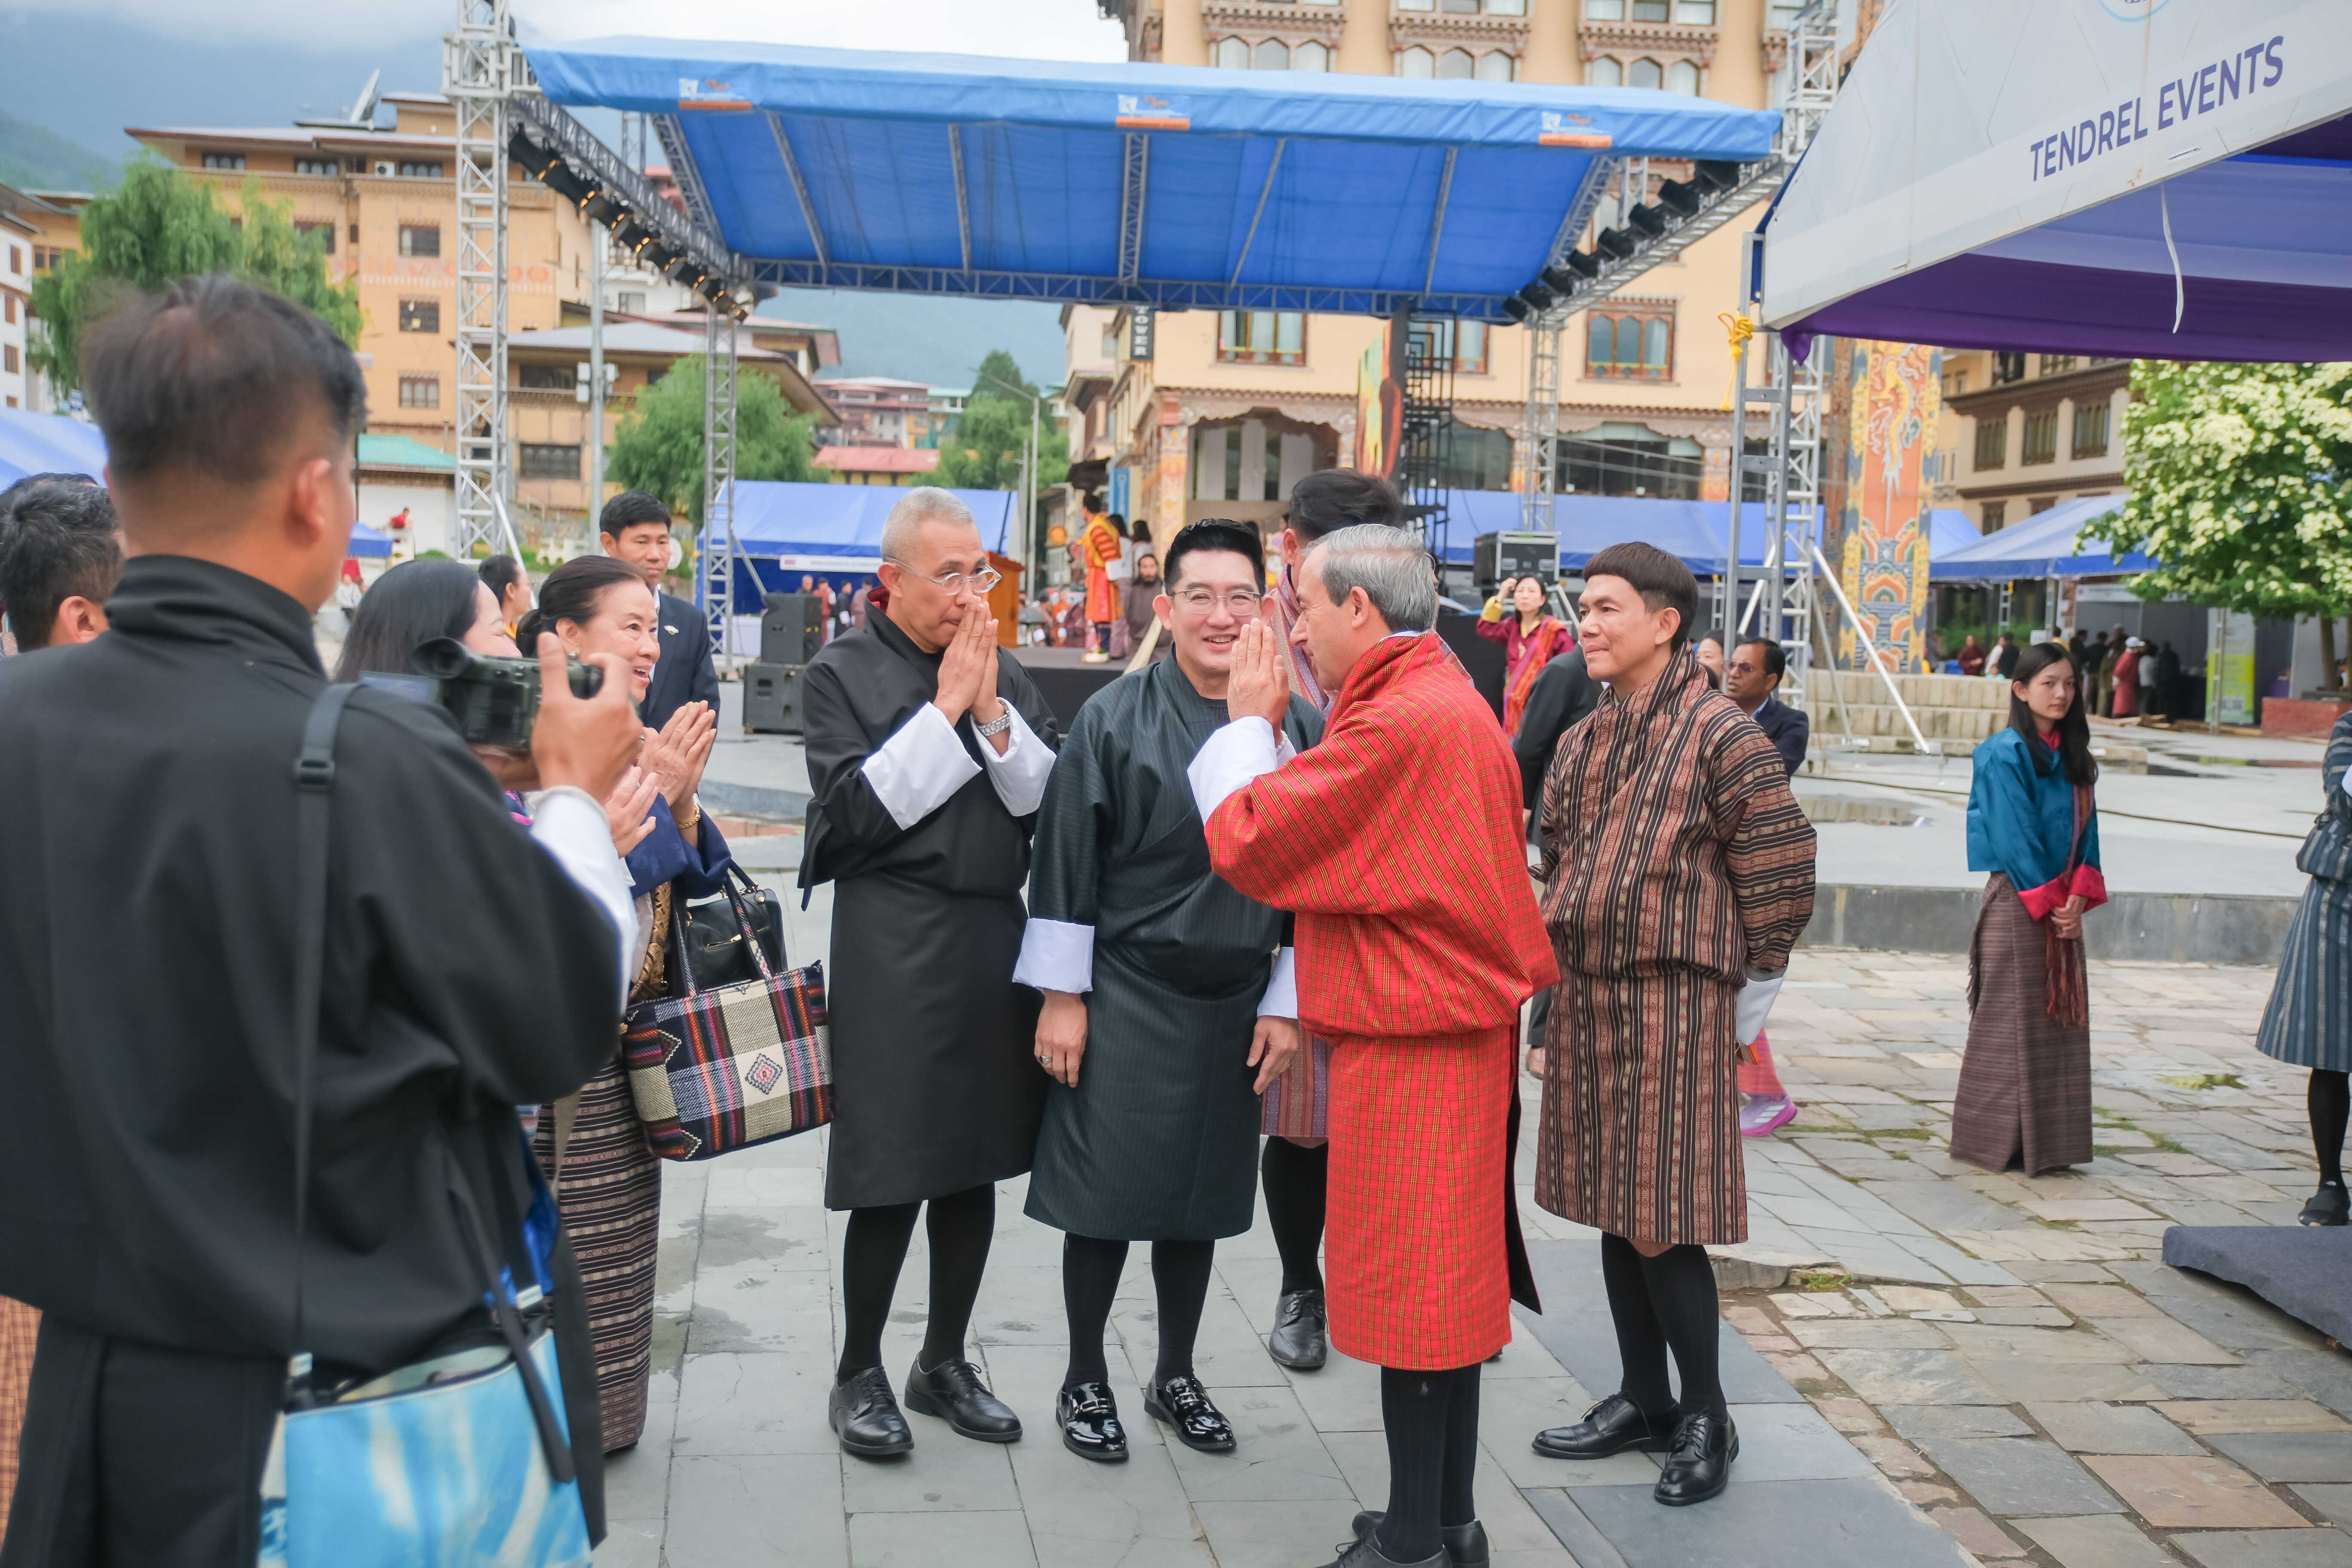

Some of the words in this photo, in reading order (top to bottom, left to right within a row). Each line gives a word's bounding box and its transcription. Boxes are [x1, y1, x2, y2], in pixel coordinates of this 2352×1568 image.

[2030, 97, 2148, 182] TENDREL
[2158, 36, 2284, 131] EVENTS
[1133, 305, 1149, 356] TOWER
